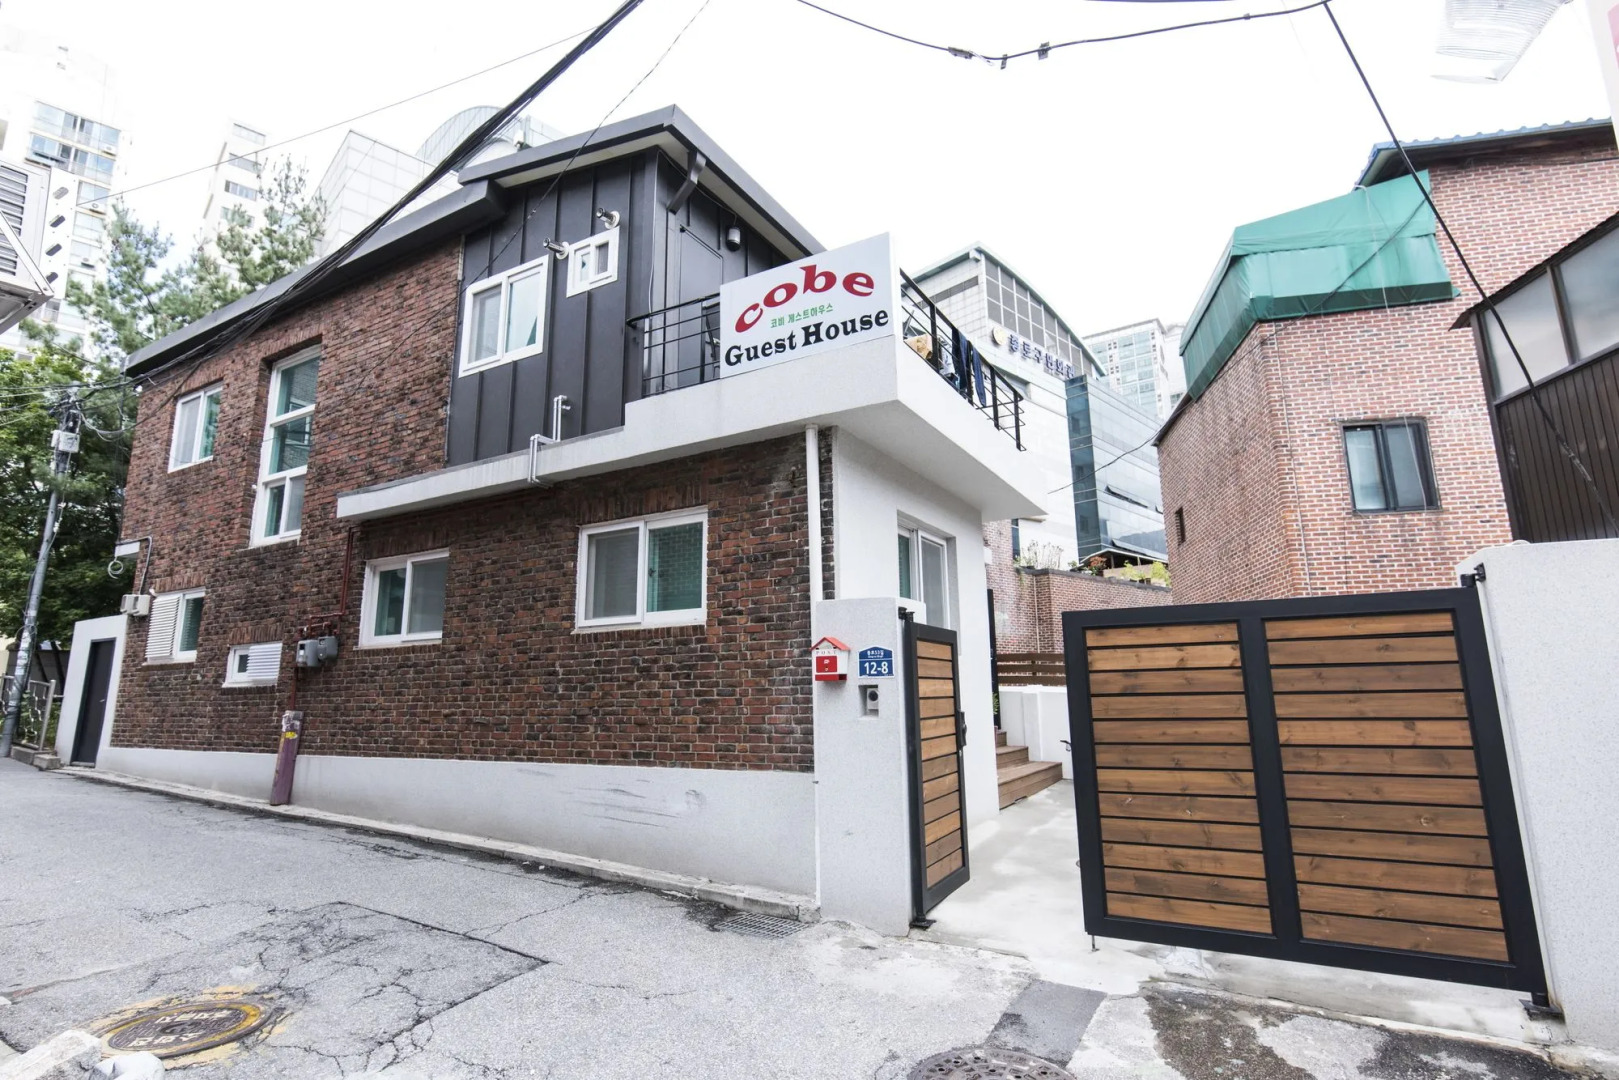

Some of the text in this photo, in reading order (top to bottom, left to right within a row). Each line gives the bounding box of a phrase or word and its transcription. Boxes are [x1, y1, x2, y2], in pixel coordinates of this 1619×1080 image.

[735, 264, 875, 333] cobe
[770, 303, 834, 328] 코비 게스트하우스
[725, 309, 889, 367] Guest House
[864, 661, 888, 675] 12-8
